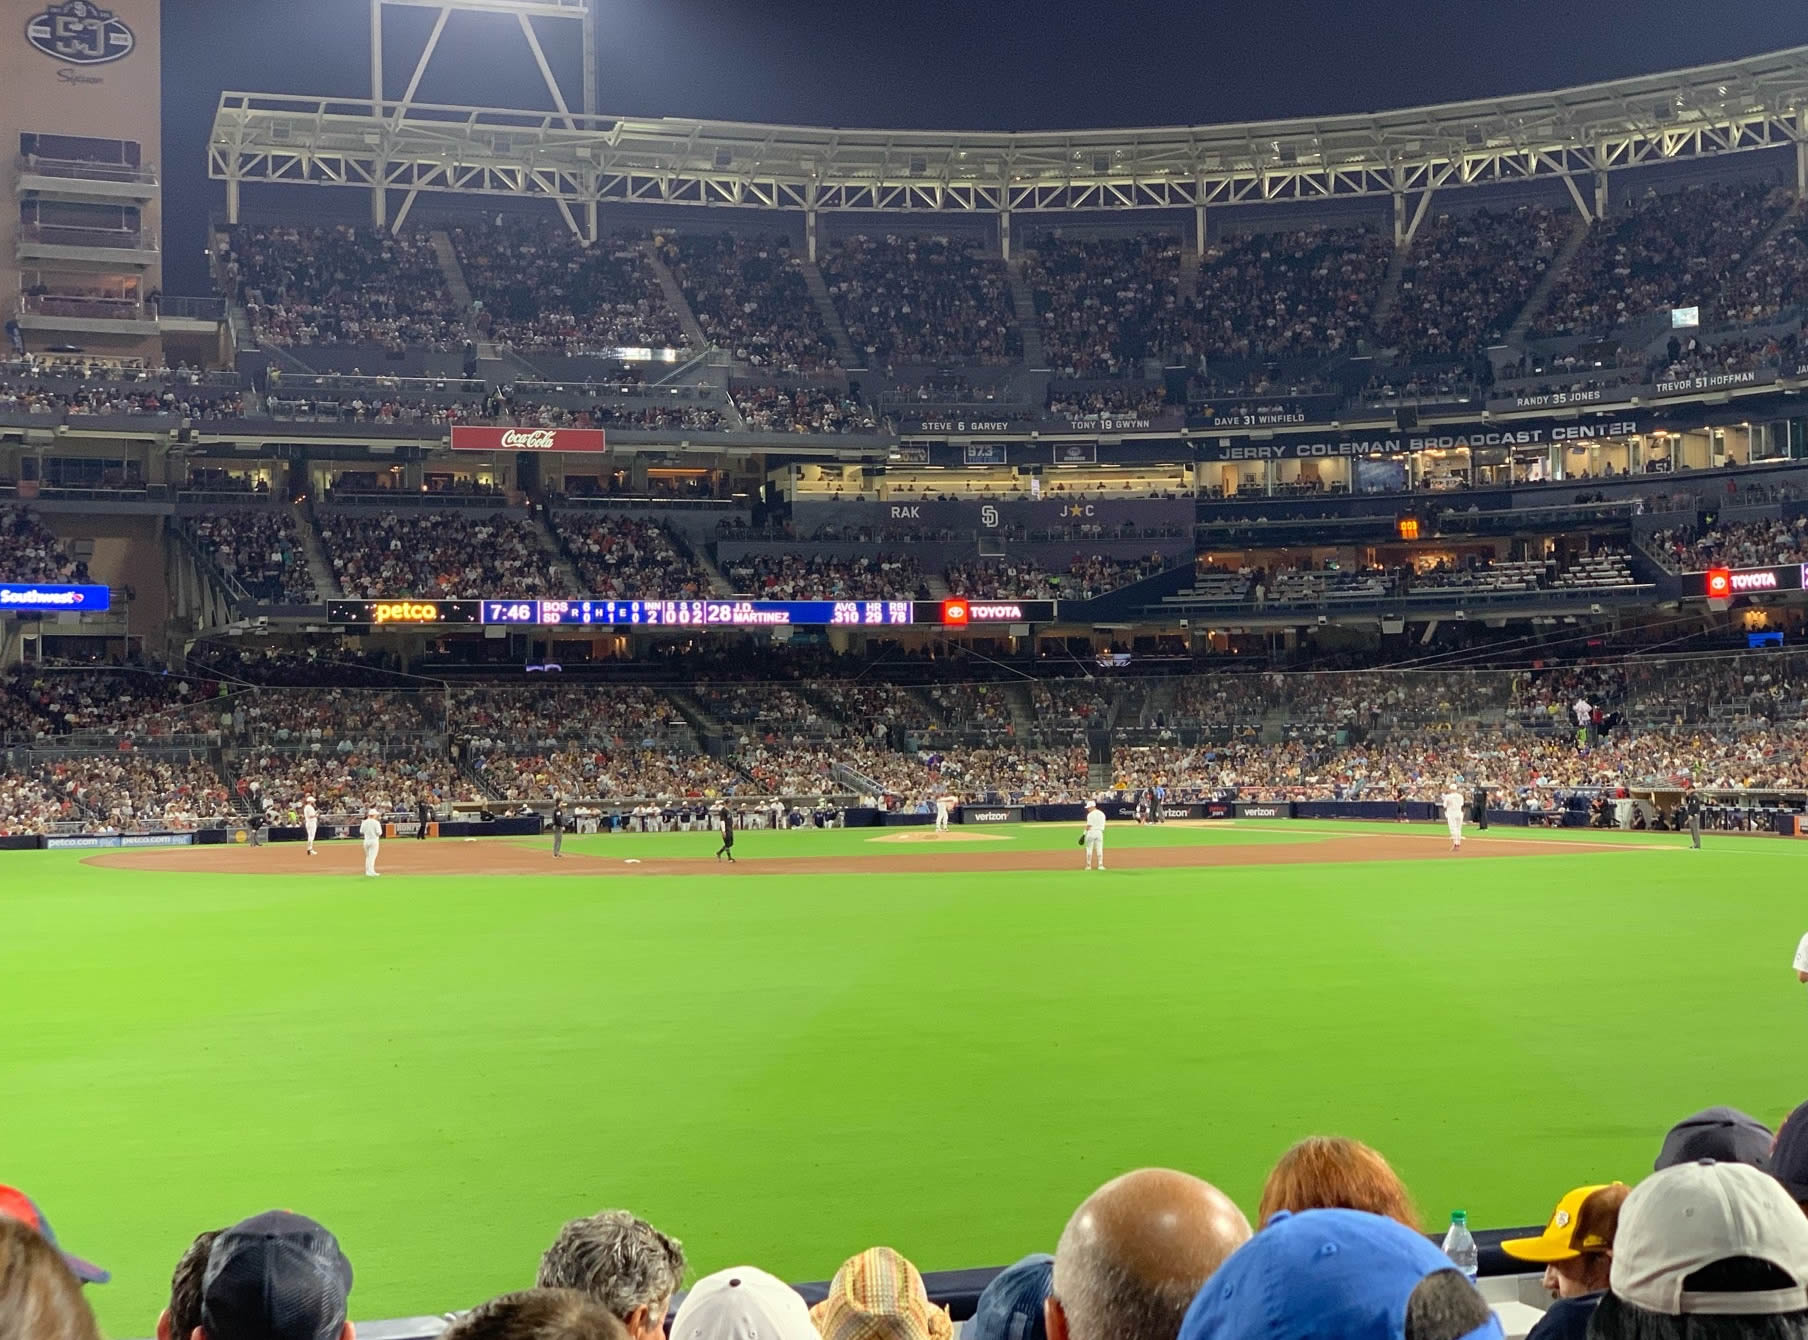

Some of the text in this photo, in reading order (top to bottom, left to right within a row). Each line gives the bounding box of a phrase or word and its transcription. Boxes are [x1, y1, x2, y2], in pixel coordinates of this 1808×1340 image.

[1656, 372, 1755, 392] TREVOR 51 HOFFMAN
[1517, 390, 1601, 407] RANDY 35 JONES
[921, 421, 1008, 431] STEVE 6 GARVEY
[1071, 420, 1150, 430] TONY 19 GWYNN
[1214, 414, 1305, 426] DAVE 31 WINFIELD
[501, 429, 557, 448] Coca-Cola
[1219, 421, 1637, 460] JERRY COLEMAN BROADCAST CENTER
[891, 506, 920, 518] RAK
[981, 505, 999, 528] SD
[1730, 572, 1776, 588] TOYOTA
[0, 590, 74, 604] Southwest
[543, 602, 640, 612] BOS 6 6 0
[644, 602, 661, 610] INN
[733, 603, 754, 613] J.D.
[834, 602, 907, 612] AVG HR RBI
[970, 606, 1021, 618] TOYOTA
[378, 602, 437, 623] petco
[490, 604, 531, 621] 7:46
[543, 612, 640, 623] SD 0 1 0
[571, 608, 627, 617] R H E
[647, 610, 658, 624] 2
[666, 610, 703, 624] 0 0 2
[707, 604, 731, 622] 28
[733, 612, 789, 624] MARTINEZ
[830, 611, 859, 623] .310
[865, 611, 882, 623] 29
[975, 811, 1008, 821] verizon
[1244, 807, 1275, 817] verizon
[49, 837, 98, 848] petco.com
[122, 835, 171, 846] petco.com
